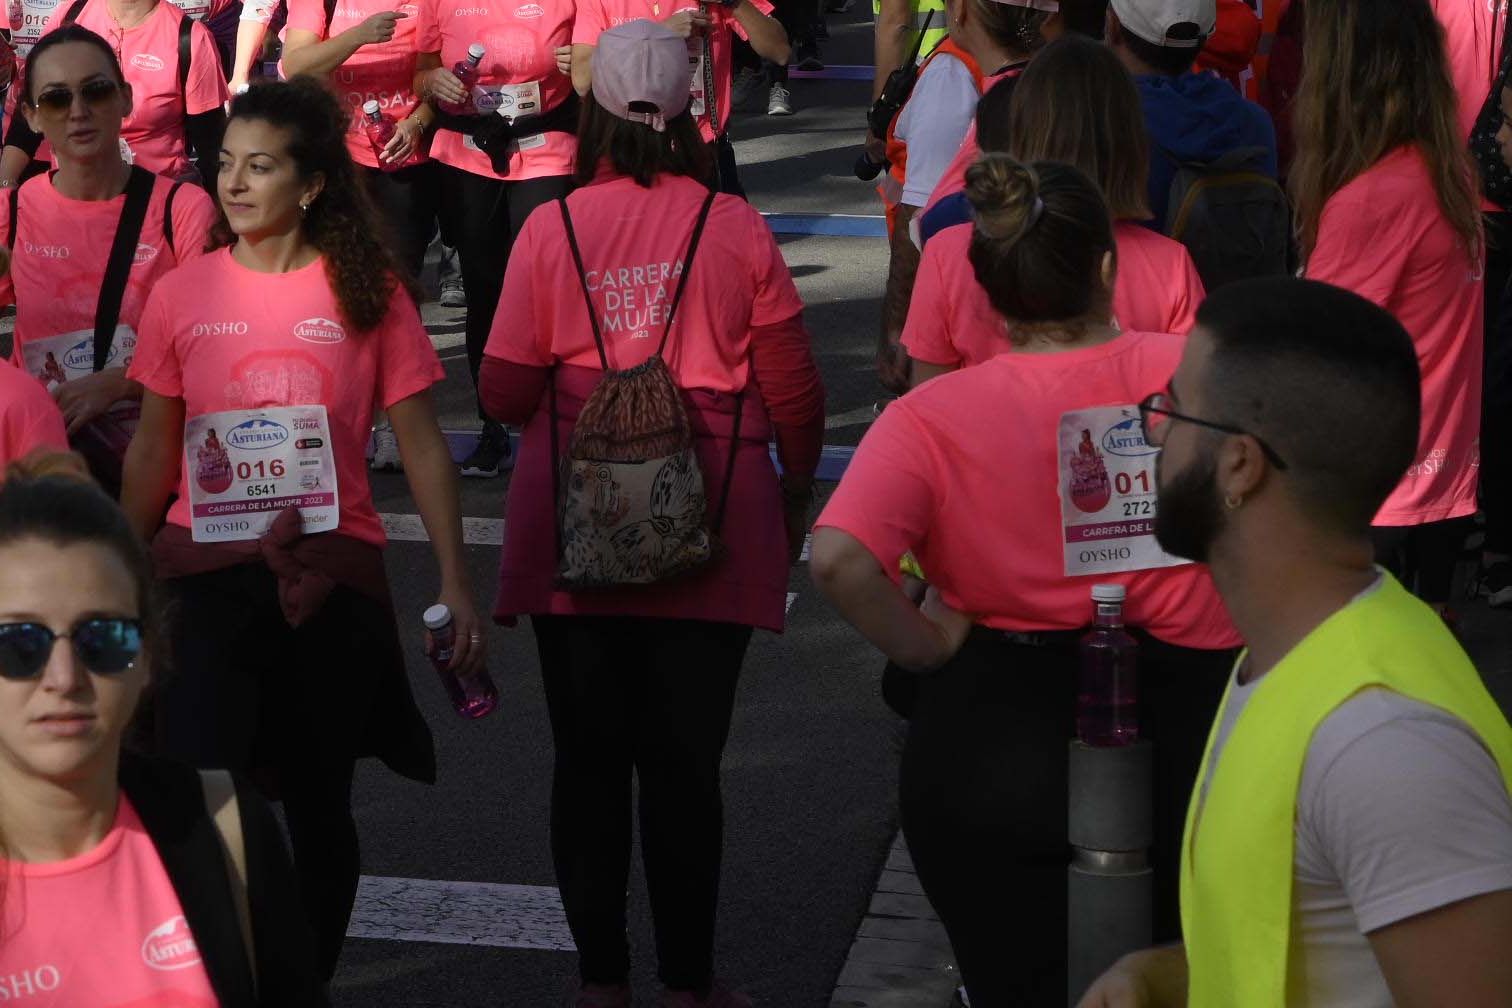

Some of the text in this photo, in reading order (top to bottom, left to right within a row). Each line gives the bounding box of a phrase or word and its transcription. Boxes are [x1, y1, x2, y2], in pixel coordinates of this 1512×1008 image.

[455, 7, 489, 17] OYSHO
[585, 257, 685, 292] CARRERA
[605, 282, 669, 312] DE LA
[603, 303, 676, 333] MUJER
[192, 321, 248, 337] OYSHO
[296, 325, 342, 340] ASTURIANA
[293, 422, 320, 430] SUMA
[231, 431, 285, 444] ASTURIANA
[237, 458, 286, 481] 016
[247, 483, 276, 496] 6541
[1114, 469, 1150, 495] 01
[207, 504, 246, 513] CARRERA
[248, 502, 259, 510] DE
[261, 501, 272, 509] LA
[304, 497, 323, 505] 2023
[205, 521, 249, 534] OYSHO
[1082, 526, 1127, 537] CARRERA
[1129, 524, 1143, 533] DE
[1079, 546, 1131, 563] OYSHO
